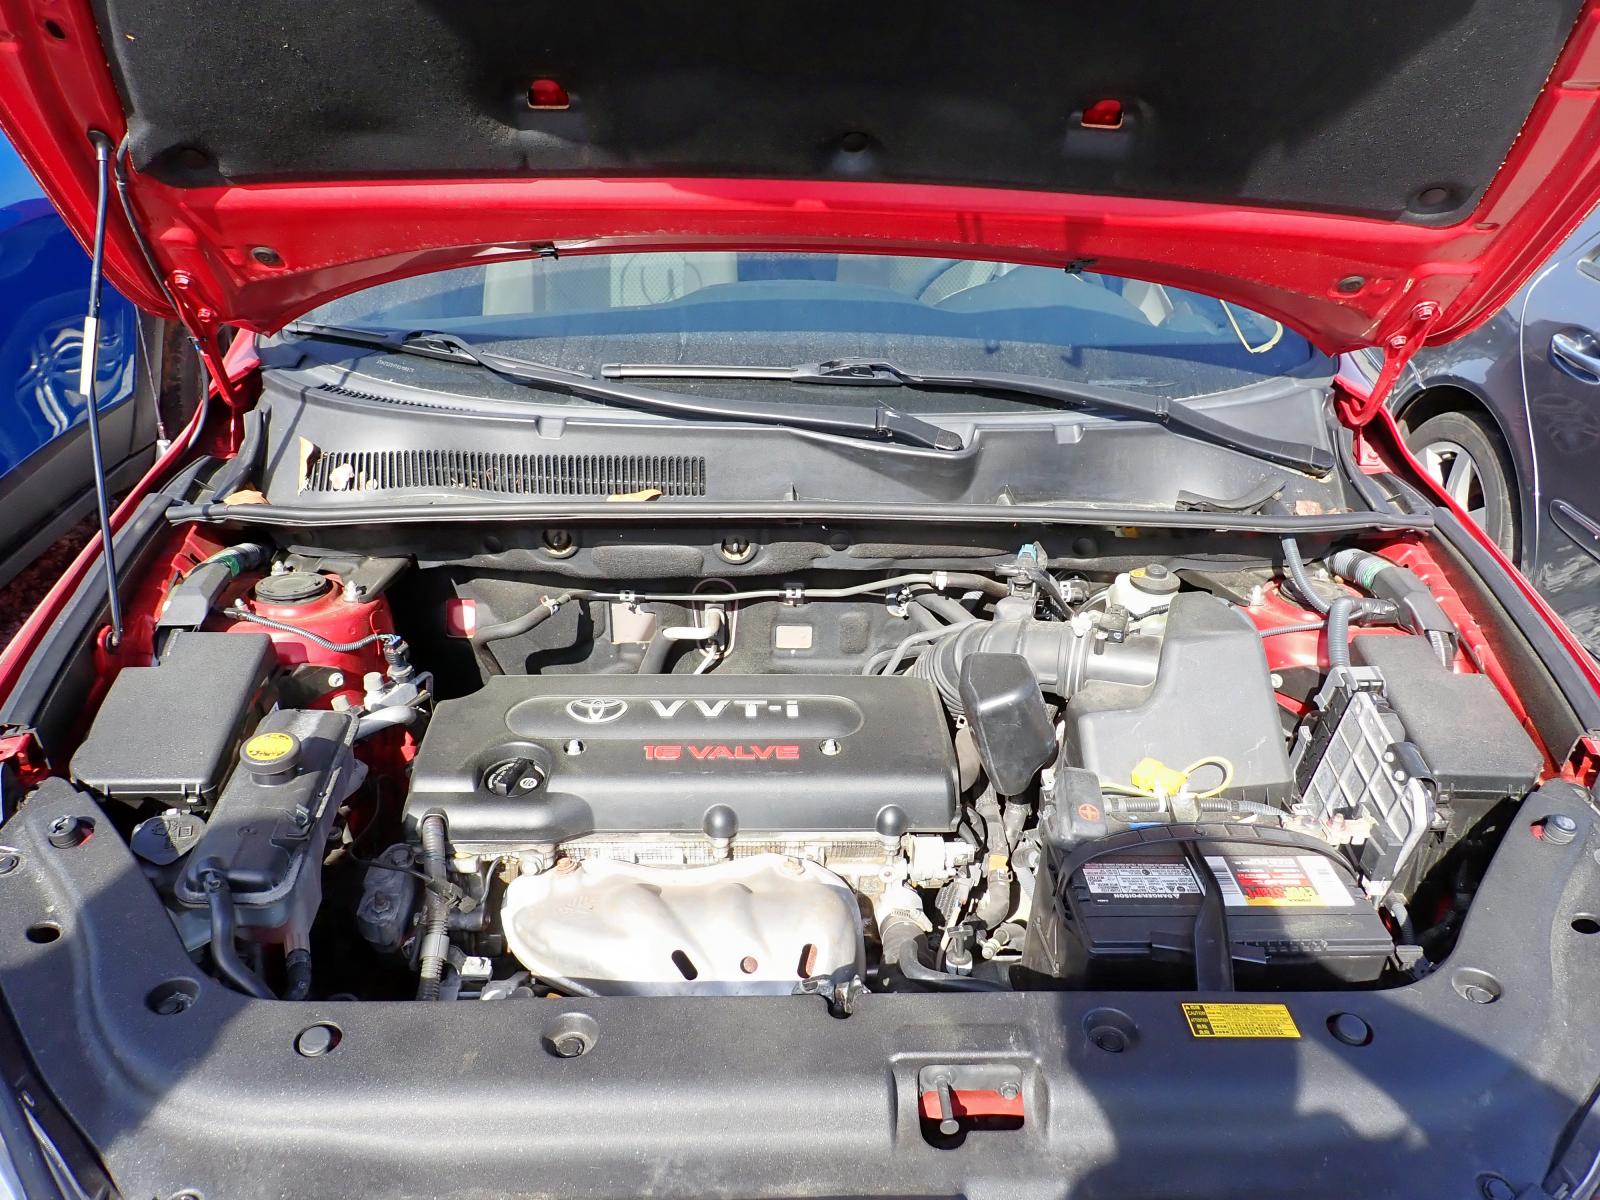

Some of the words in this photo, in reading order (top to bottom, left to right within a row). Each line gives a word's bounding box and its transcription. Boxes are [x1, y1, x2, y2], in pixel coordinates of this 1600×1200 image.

[647, 699, 800, 718] VVT-i
[643, 745, 682, 760] 16
[688, 744, 801, 760] VALVE
